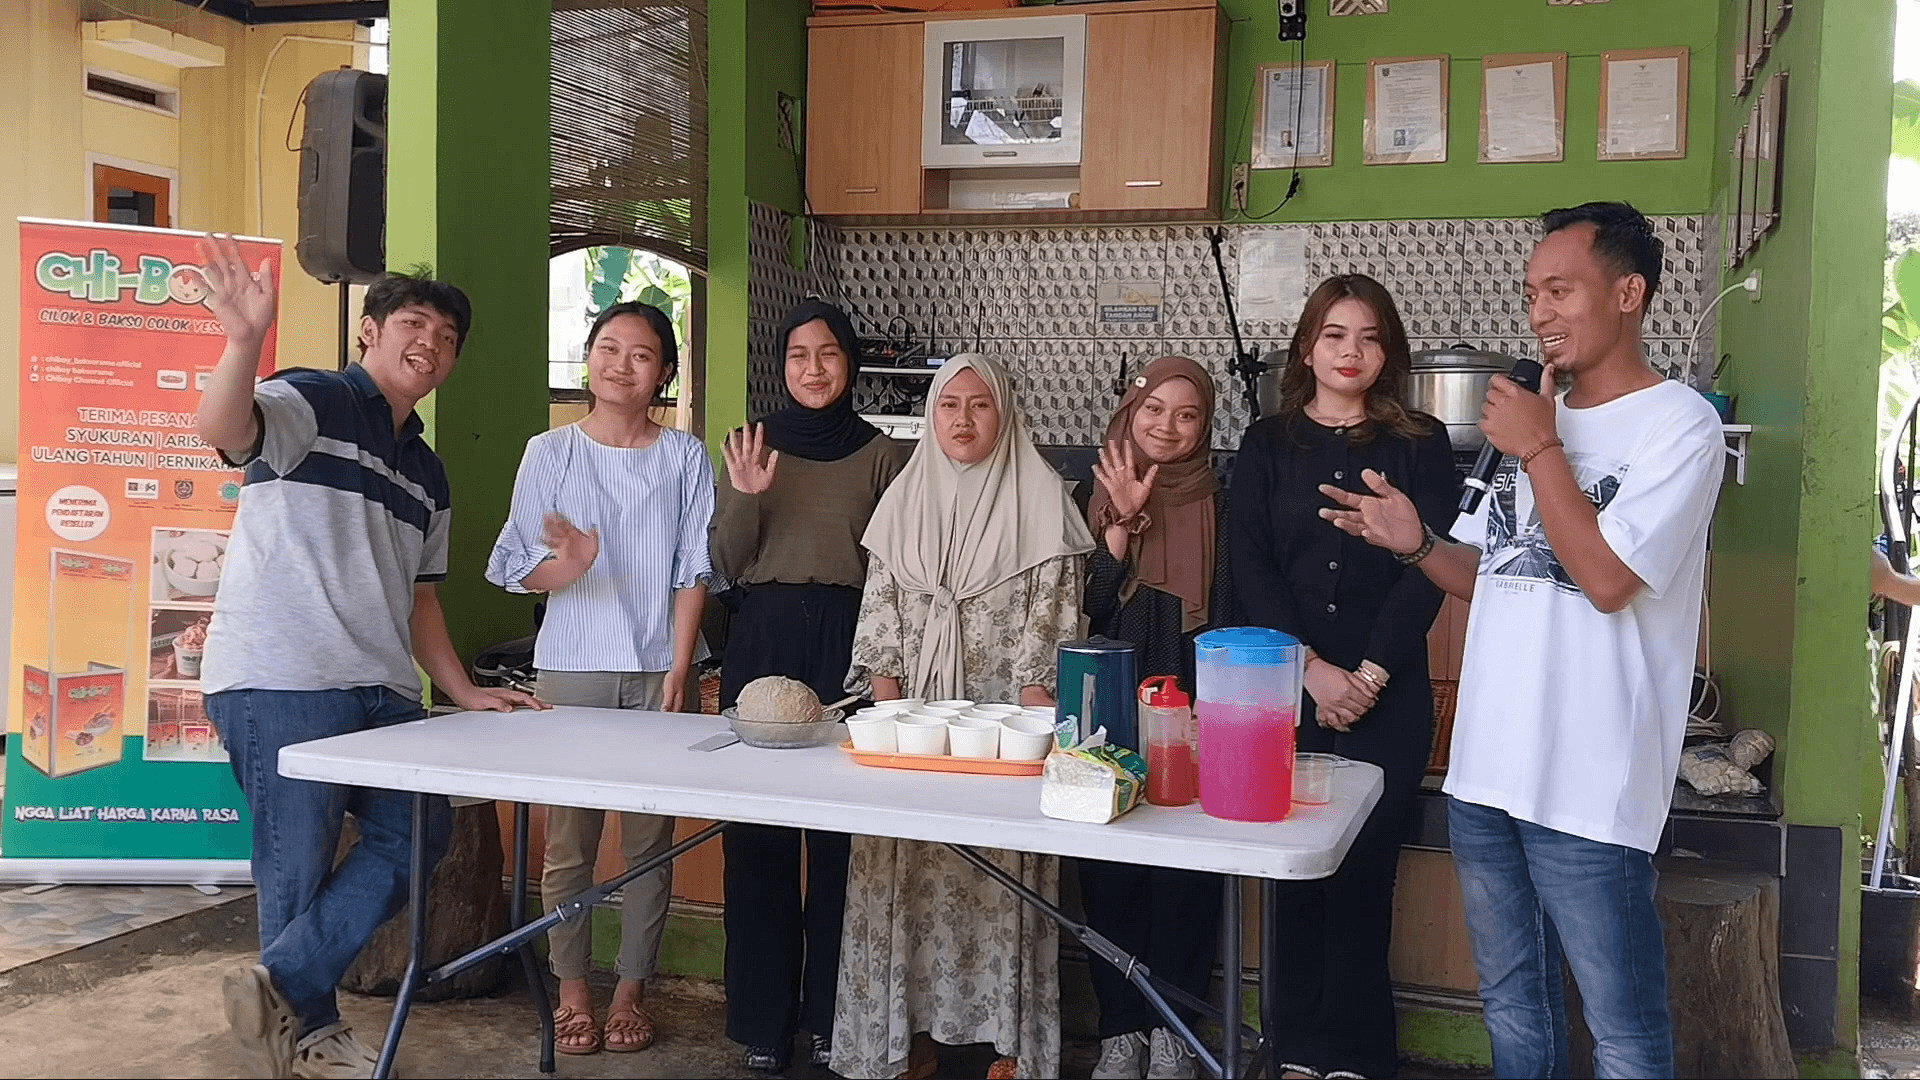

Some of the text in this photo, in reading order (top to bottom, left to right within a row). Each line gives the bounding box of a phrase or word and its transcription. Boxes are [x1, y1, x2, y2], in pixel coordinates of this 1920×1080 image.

[39, 309, 79, 323] CILOK
[82, 312, 94, 325] &
[98, 313, 143, 328] BAKSO
[147, 316, 190, 331] COLOK
[79, 408, 198, 427] TERIMA PESANA
[67, 429, 153, 445] SYUKURAN
[165, 435, 215, 448] ARISA
[33, 448, 88, 462] ULANG
[94, 451, 144, 465] TAHUN
[60, 519, 94, 528] RESELLER
[14, 805, 55, 822] NGGA
[97, 806, 147, 822] HARGA
[150, 807, 198, 823] KARNA
[201, 808, 240, 823] RASA
